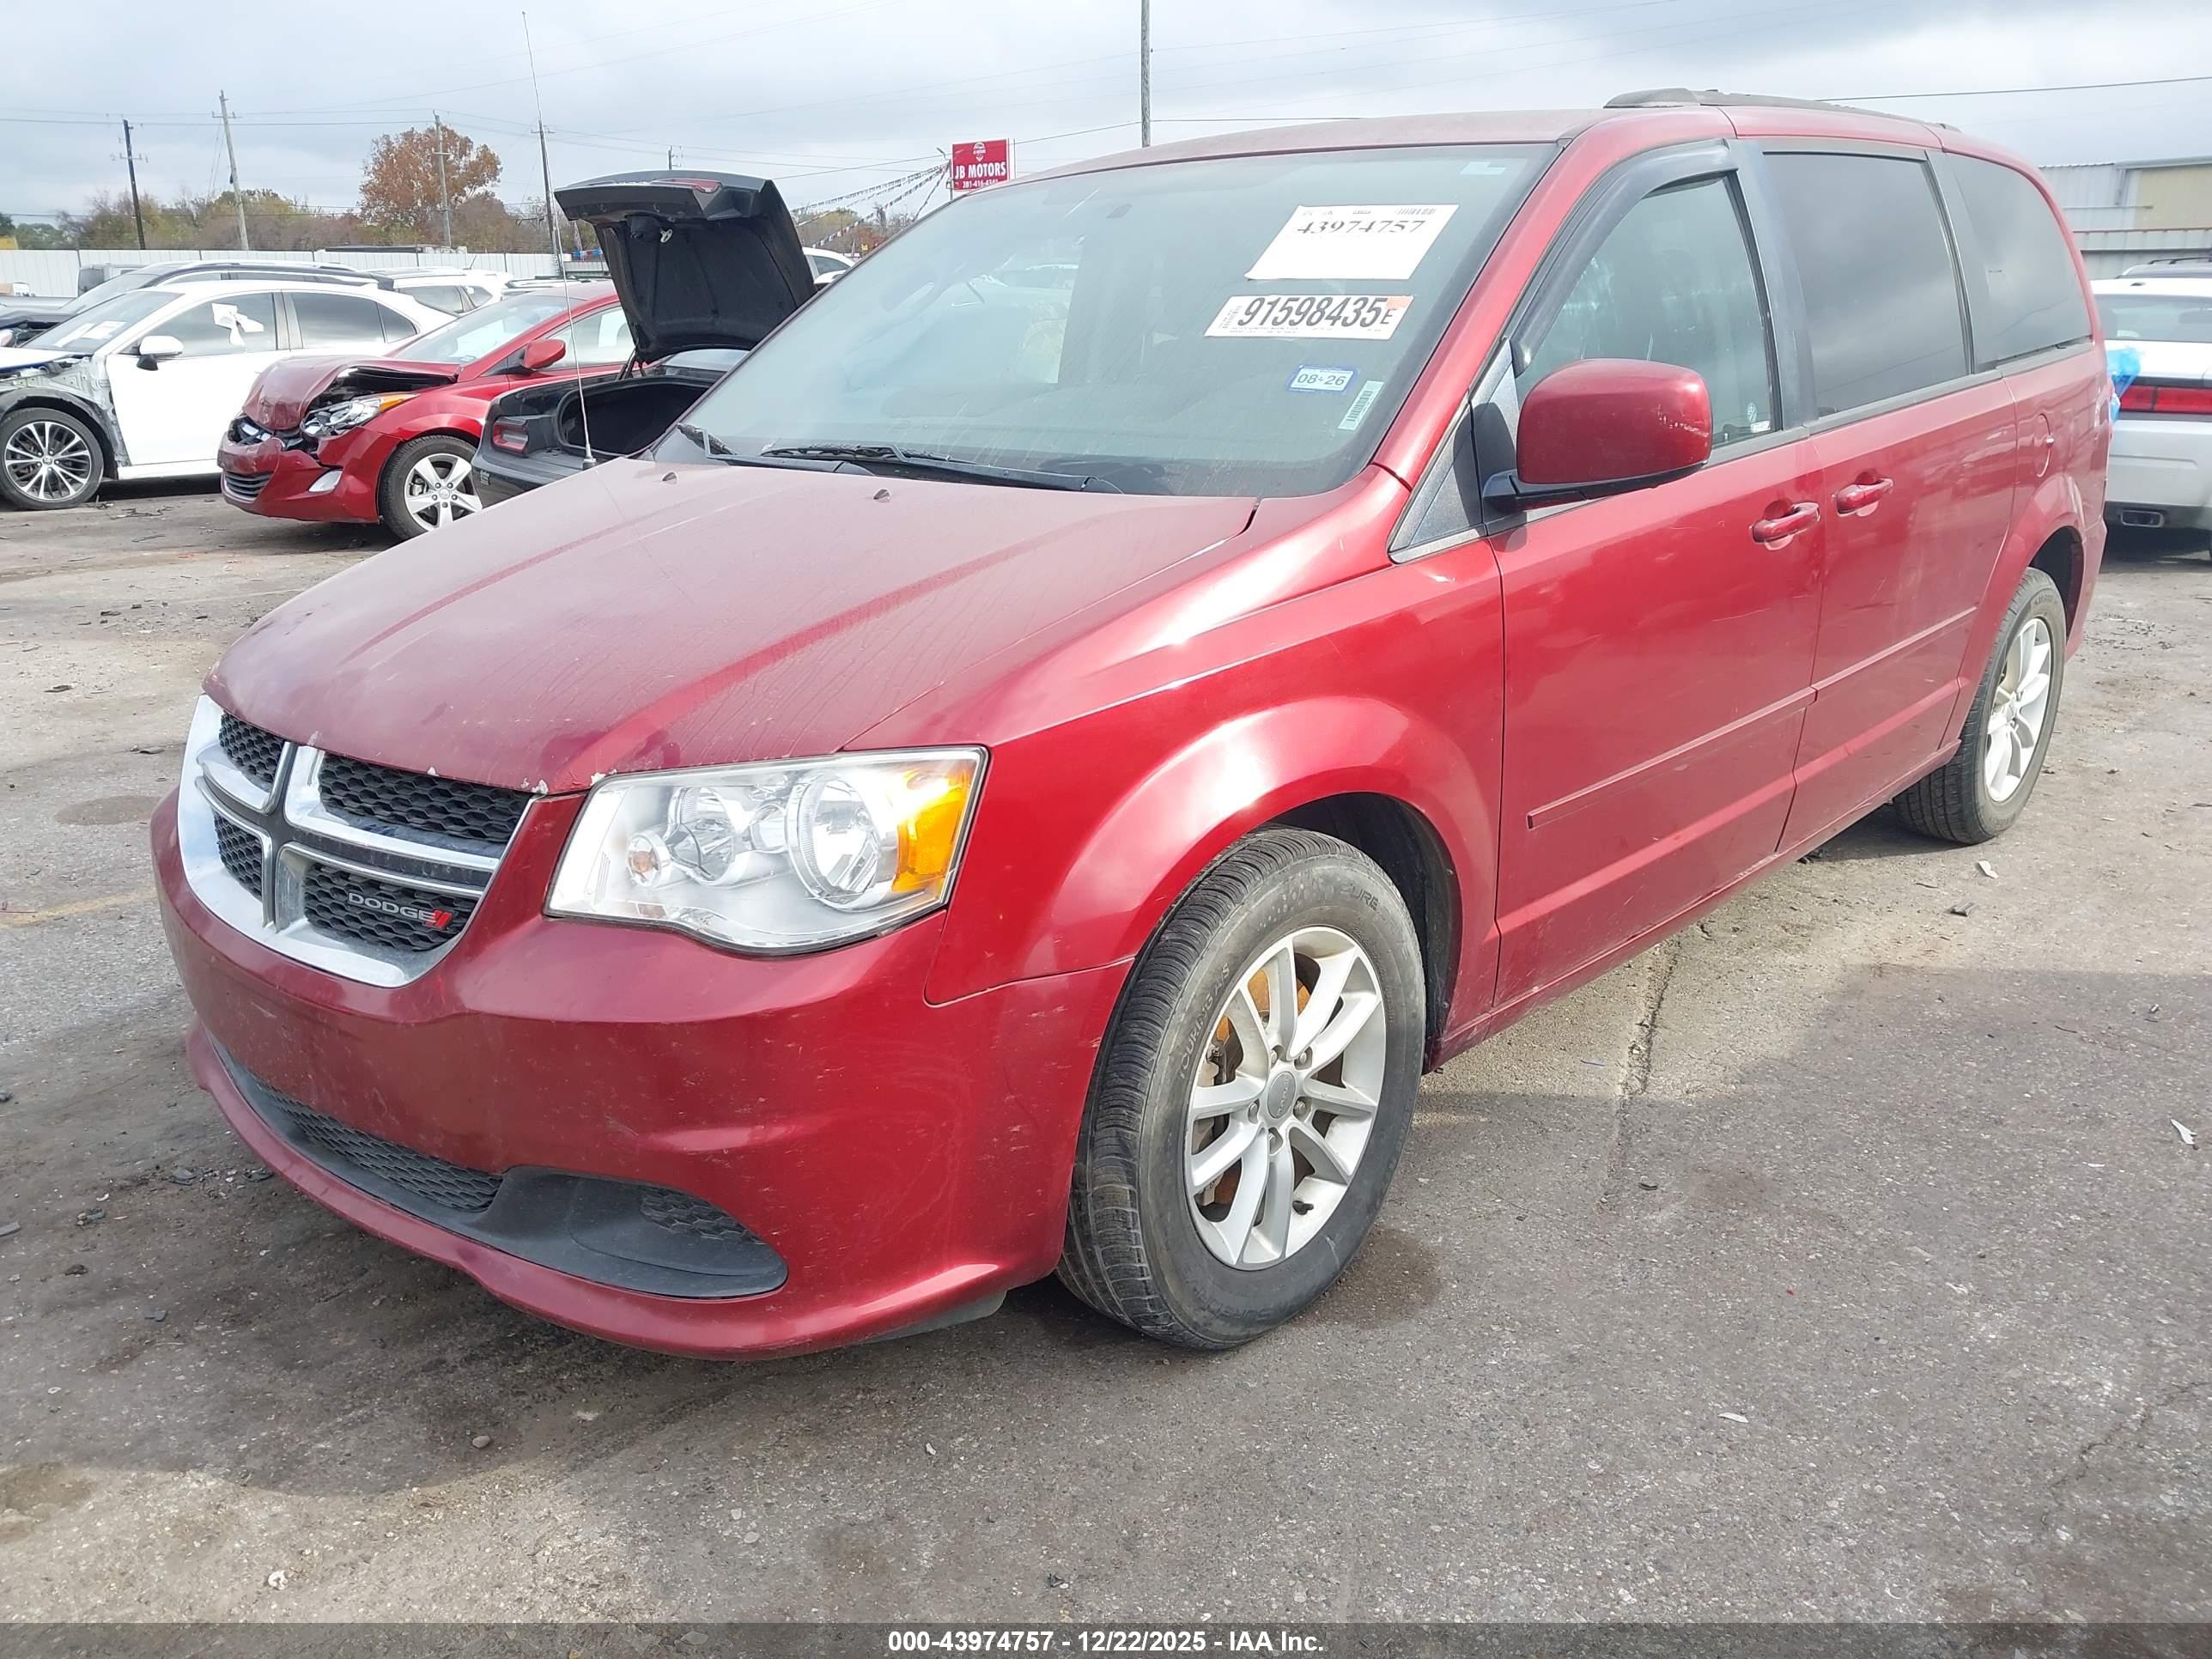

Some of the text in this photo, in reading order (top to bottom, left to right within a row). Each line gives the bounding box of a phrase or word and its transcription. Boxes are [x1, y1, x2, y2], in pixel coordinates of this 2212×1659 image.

[955, 161, 1006, 179] JB MOTORS
[1297, 220, 1426, 234] 43974757
[349, 892, 436, 923] DODGE
